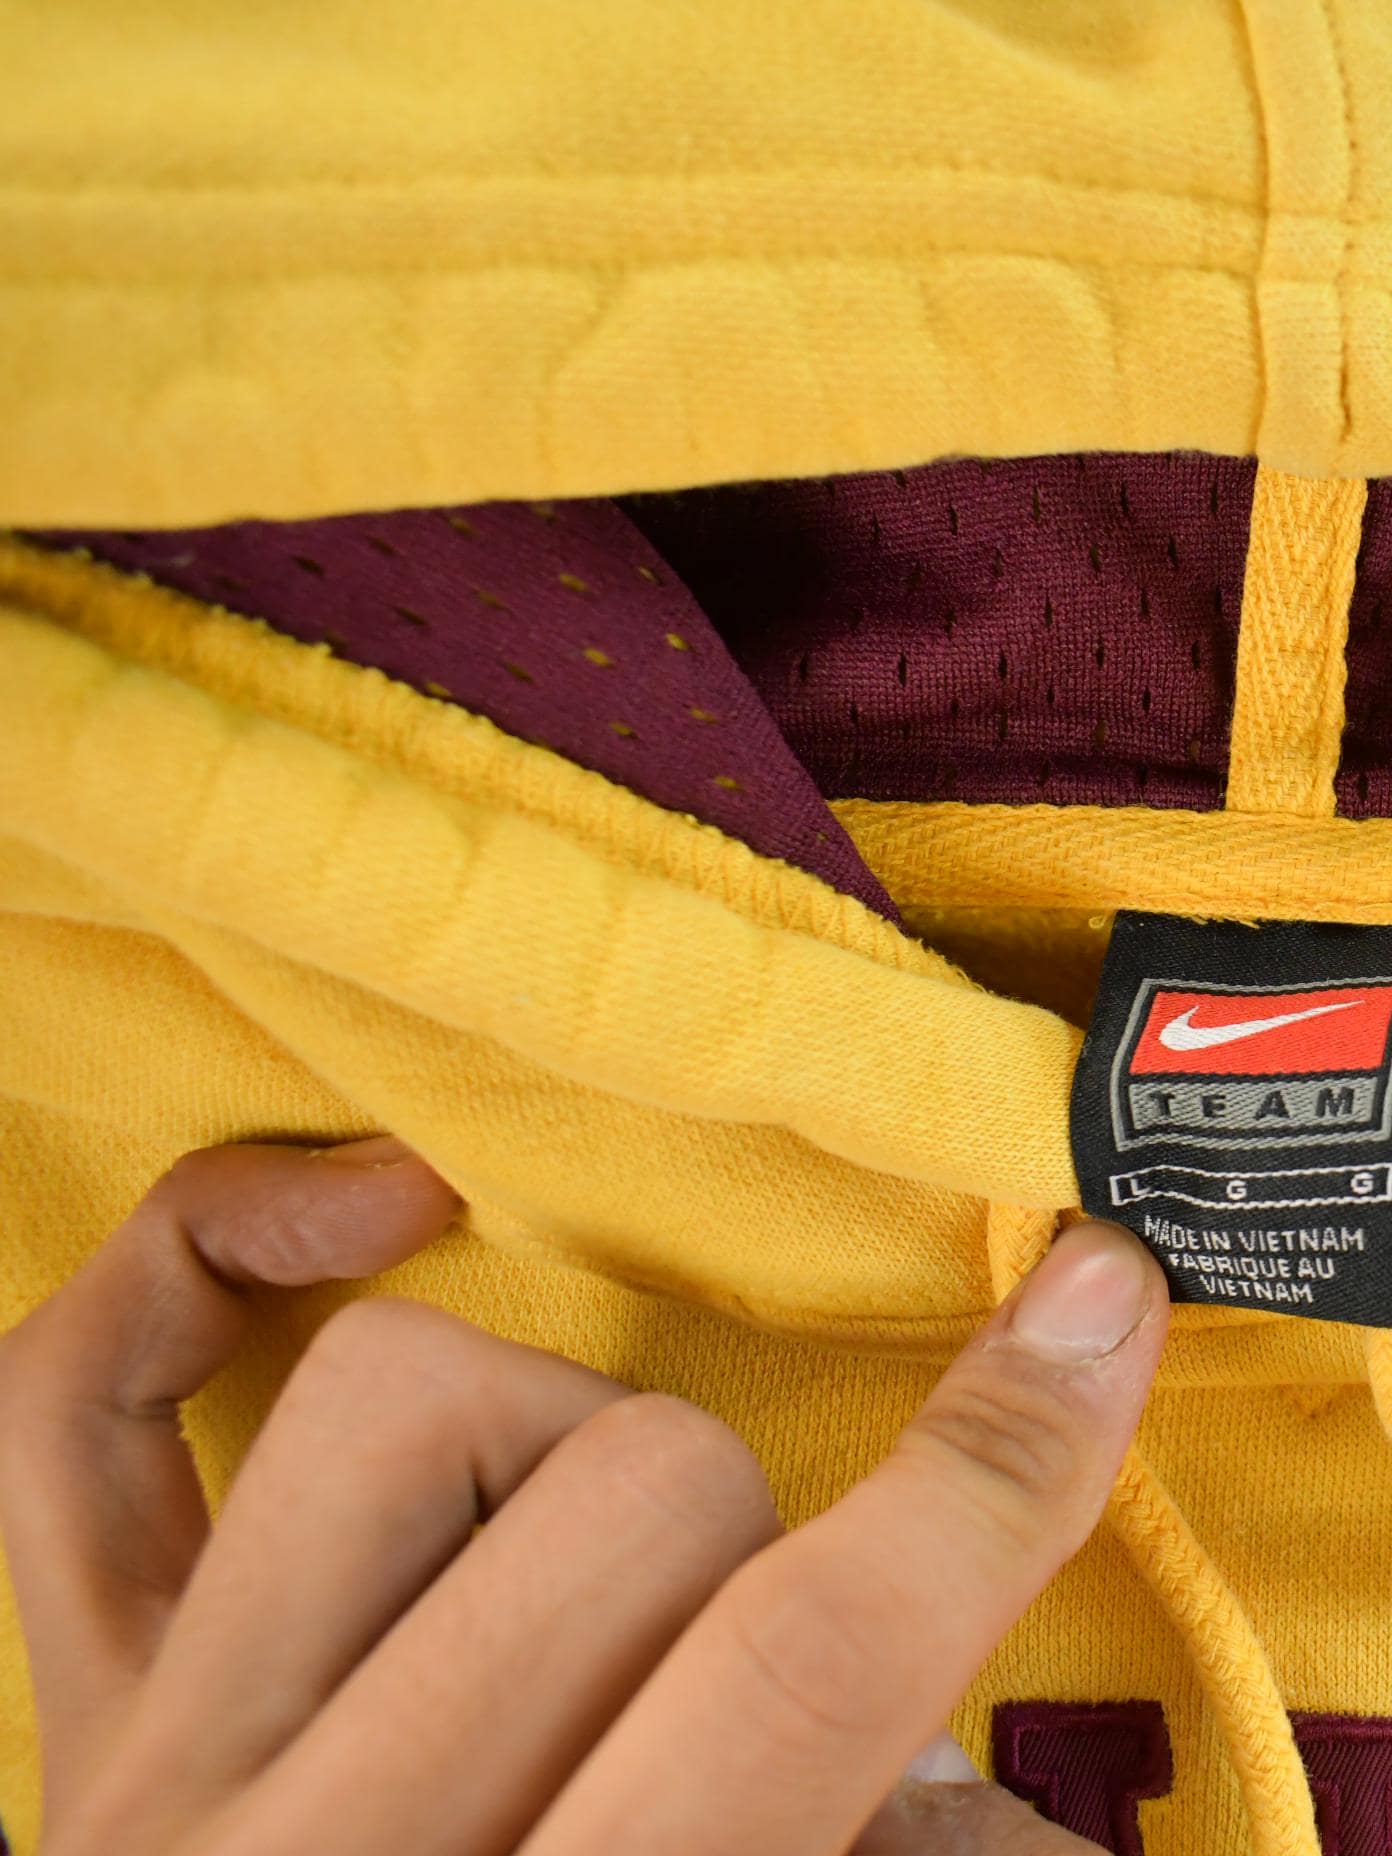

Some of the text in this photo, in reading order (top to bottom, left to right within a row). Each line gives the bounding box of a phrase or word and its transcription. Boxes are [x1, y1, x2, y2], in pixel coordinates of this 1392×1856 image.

[1148, 1085, 1356, 1122] TEAM
[1130, 1172, 1374, 1200] L G G
[1143, 1214, 1365, 1252] MADE IN VIETNAM
[1168, 1252, 1336, 1281] FABRIQUE AU
[1200, 1274, 1314, 1304] VIETNAM
